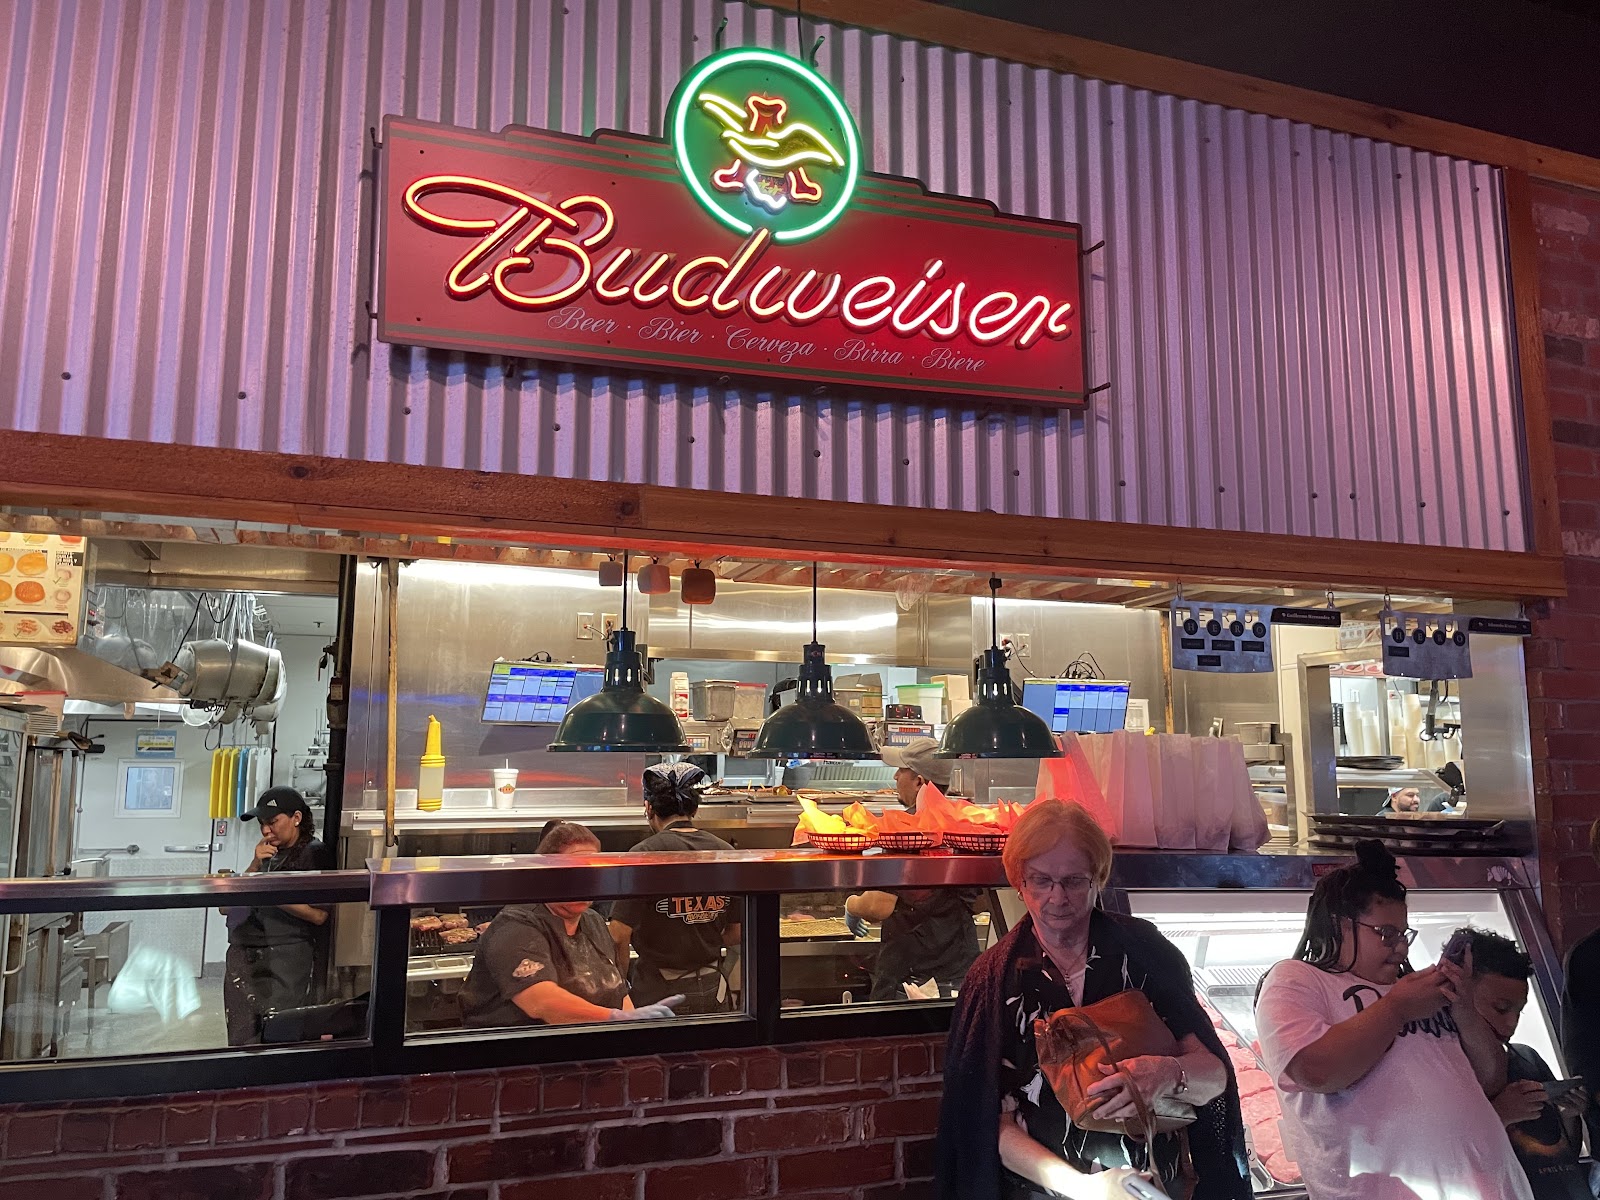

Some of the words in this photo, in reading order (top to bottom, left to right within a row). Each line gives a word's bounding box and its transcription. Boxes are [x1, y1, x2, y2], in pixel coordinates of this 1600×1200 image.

[402, 174, 1074, 350] Budweiser
[547, 306, 620, 334] Beer
[638, 316, 703, 344] Bier
[725, 324, 817, 364] Cerveza
[833, 338, 905, 365] Birra
[921, 347, 987, 372] Biere
[671, 895, 726, 913] TEXAS
